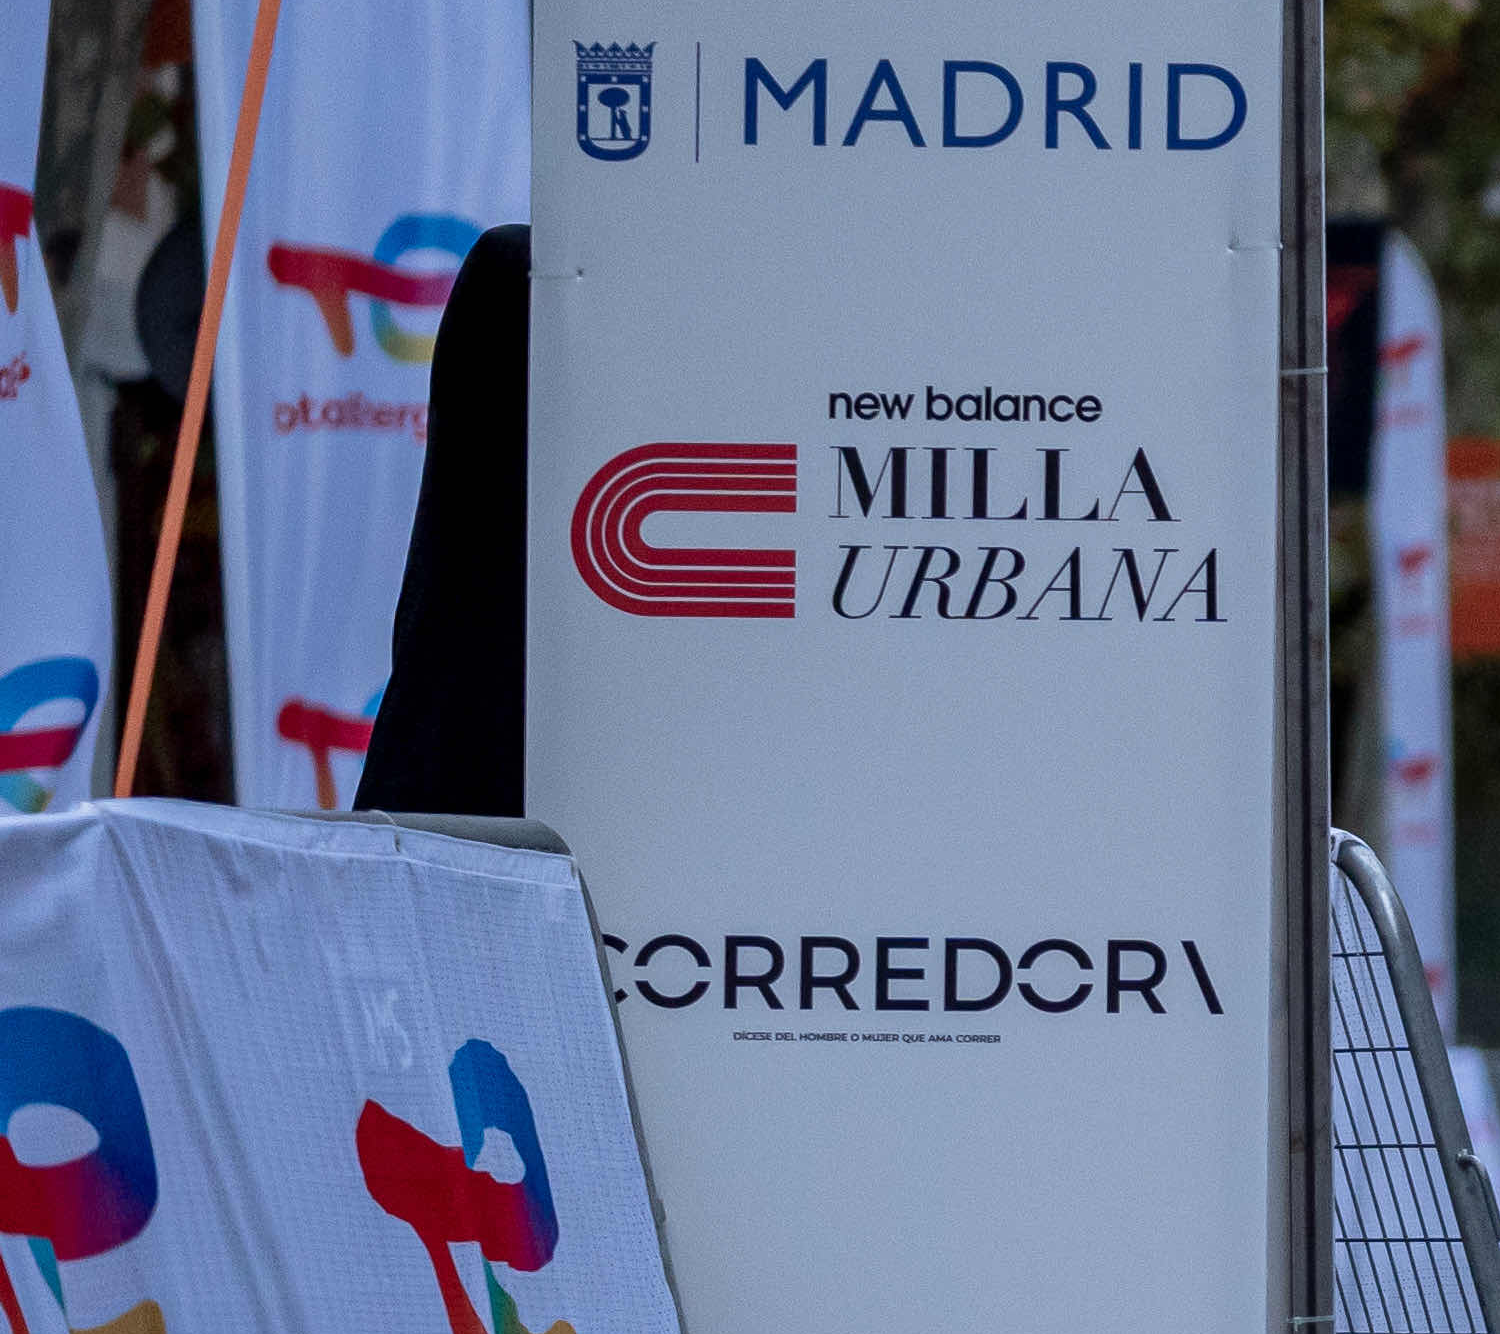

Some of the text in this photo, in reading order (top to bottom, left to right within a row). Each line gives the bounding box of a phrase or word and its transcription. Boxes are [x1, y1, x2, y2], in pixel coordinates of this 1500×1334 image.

[743, 56, 1248, 151] MADRID
[828, 384, 1104, 424] new balance
[828, 445, 1182, 524] MILLA
[828, 544, 1229, 624] URBANA
[775, 1031, 797, 1042] DEL
[799, 1032, 848, 1042] HOMBRE
[862, 1033, 899, 1043] MUJER
[902, 1033, 926, 1044] QUE
[928, 1034, 953, 1043] AMA
[955, 1034, 1001, 1044] CORRER
